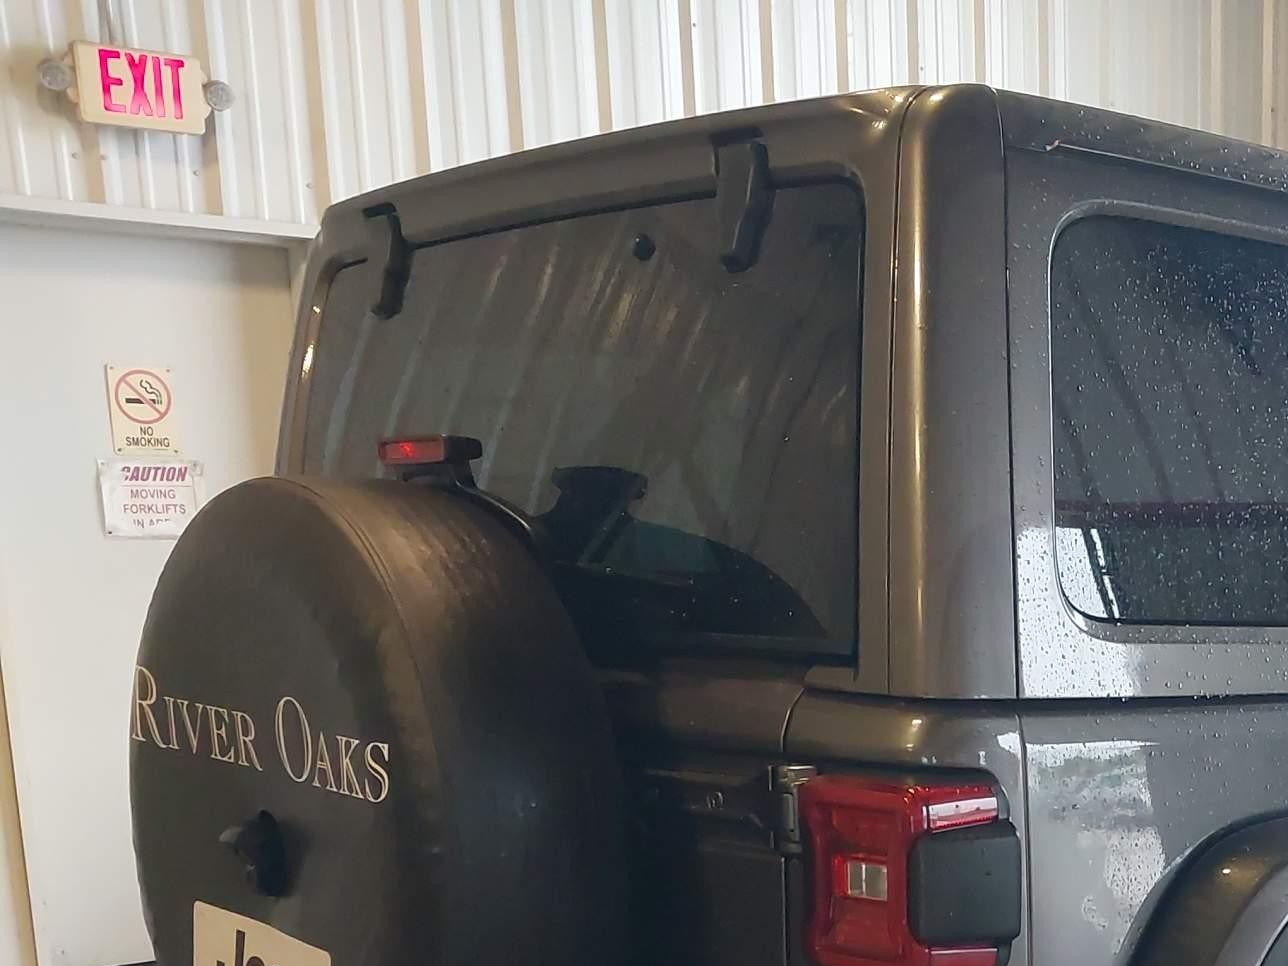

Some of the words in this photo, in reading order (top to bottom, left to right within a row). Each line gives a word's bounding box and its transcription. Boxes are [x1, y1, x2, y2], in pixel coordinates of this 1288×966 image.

[98, 48, 185, 120] EXIT
[139, 426, 154, 437] NO
[125, 437, 170, 447] SMOKING
[130, 489, 176, 500] MOVING
[123, 504, 186, 514] FORKLIFTS
[132, 664, 264, 772] RIVER
[274, 696, 390, 803] OAKS
